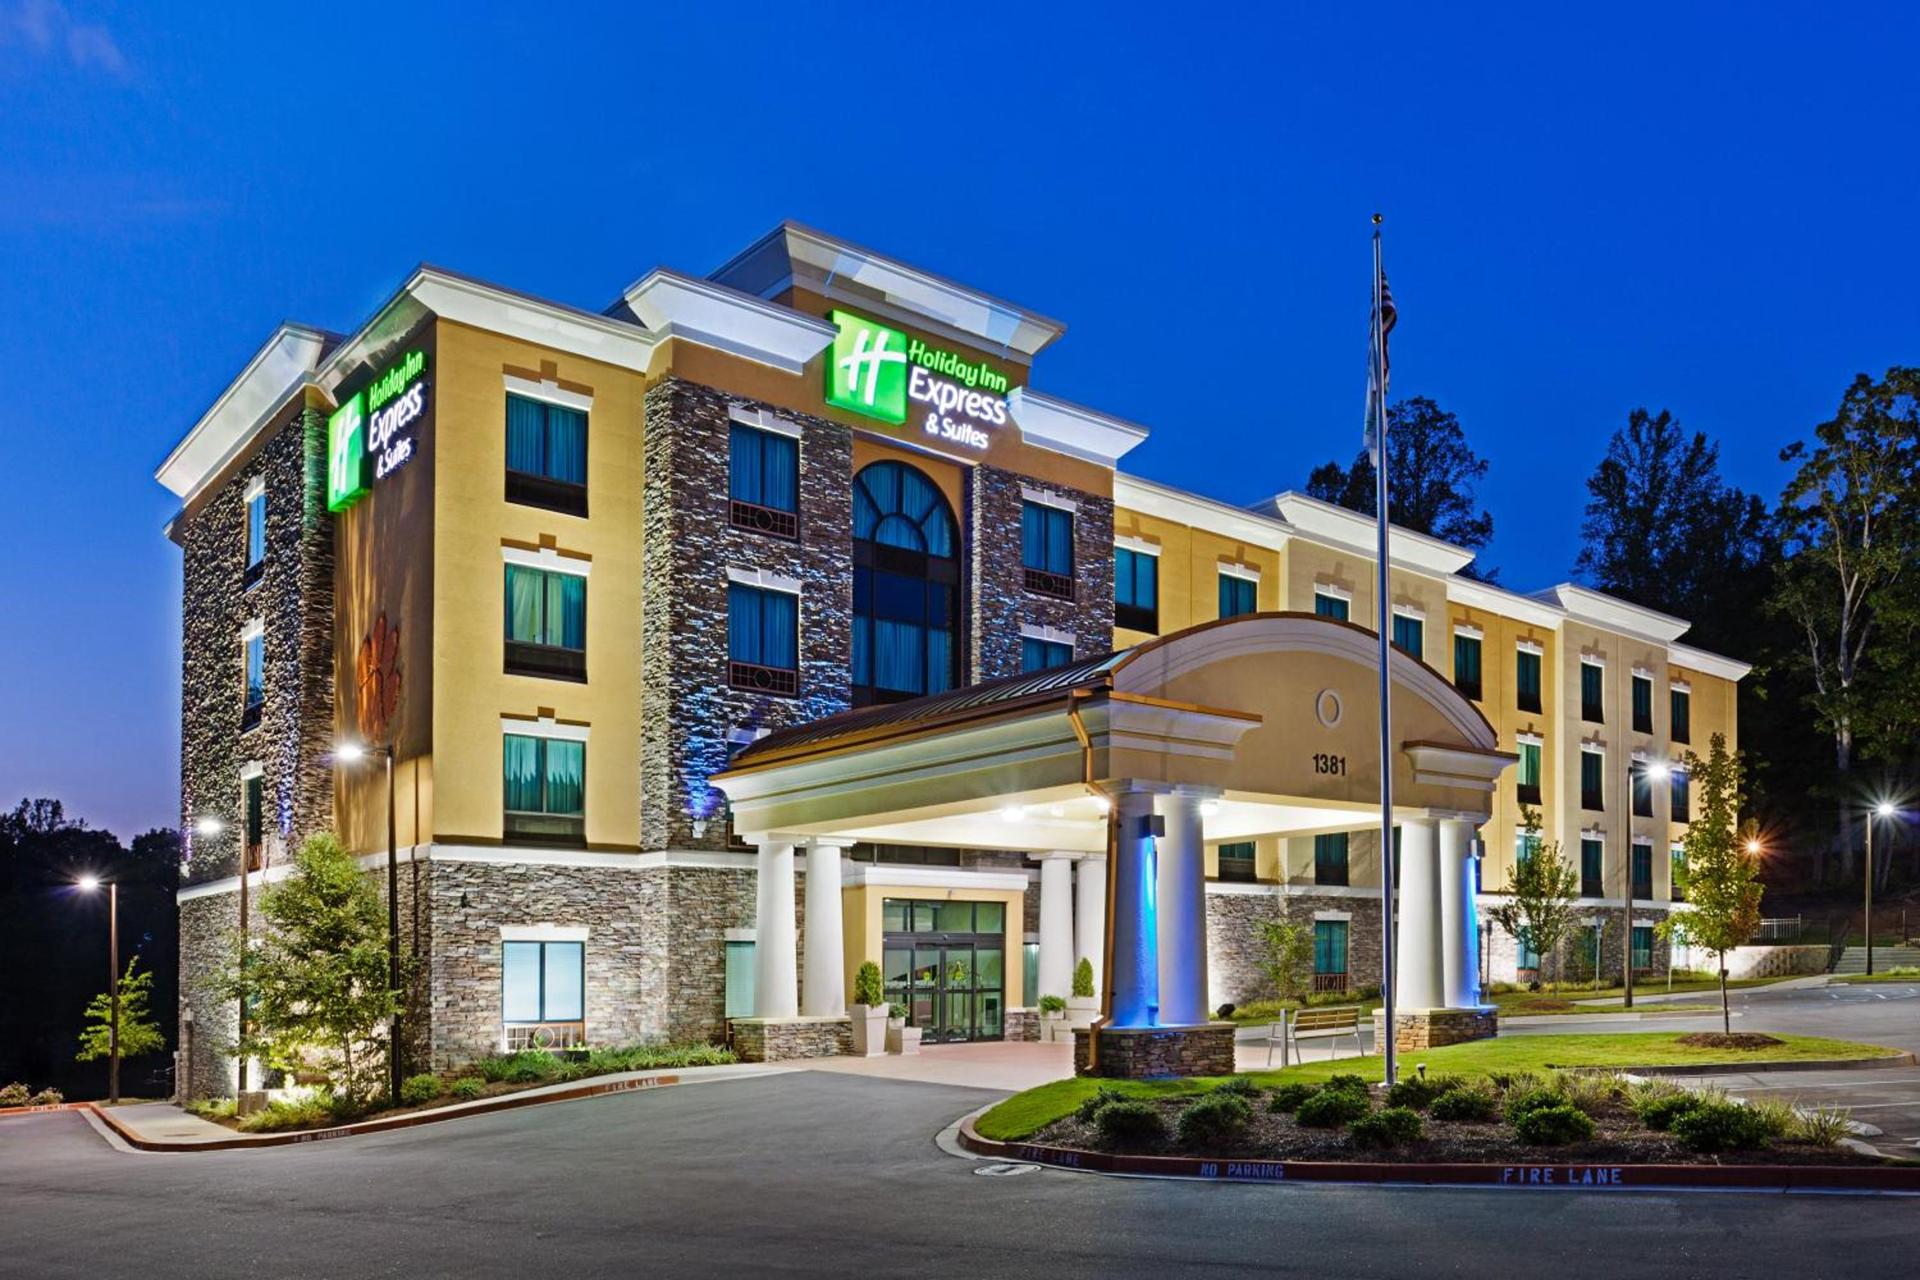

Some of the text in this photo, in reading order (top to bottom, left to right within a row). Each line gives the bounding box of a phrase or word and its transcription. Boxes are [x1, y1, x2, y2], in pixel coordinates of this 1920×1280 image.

[369, 351, 424, 413] Holiday Inn
[909, 340, 1007, 393] Holiday Inn
[909, 366, 1006, 424] Express
[368, 382, 424, 452] Express
[925, 412, 989, 450] & Suites
[376, 437, 412, 479] & Suites
[1312, 753, 1346, 776] 1381
[1201, 1162, 1284, 1178] NO PARKING
[1503, 1167, 1622, 1184] FIRE LANE
